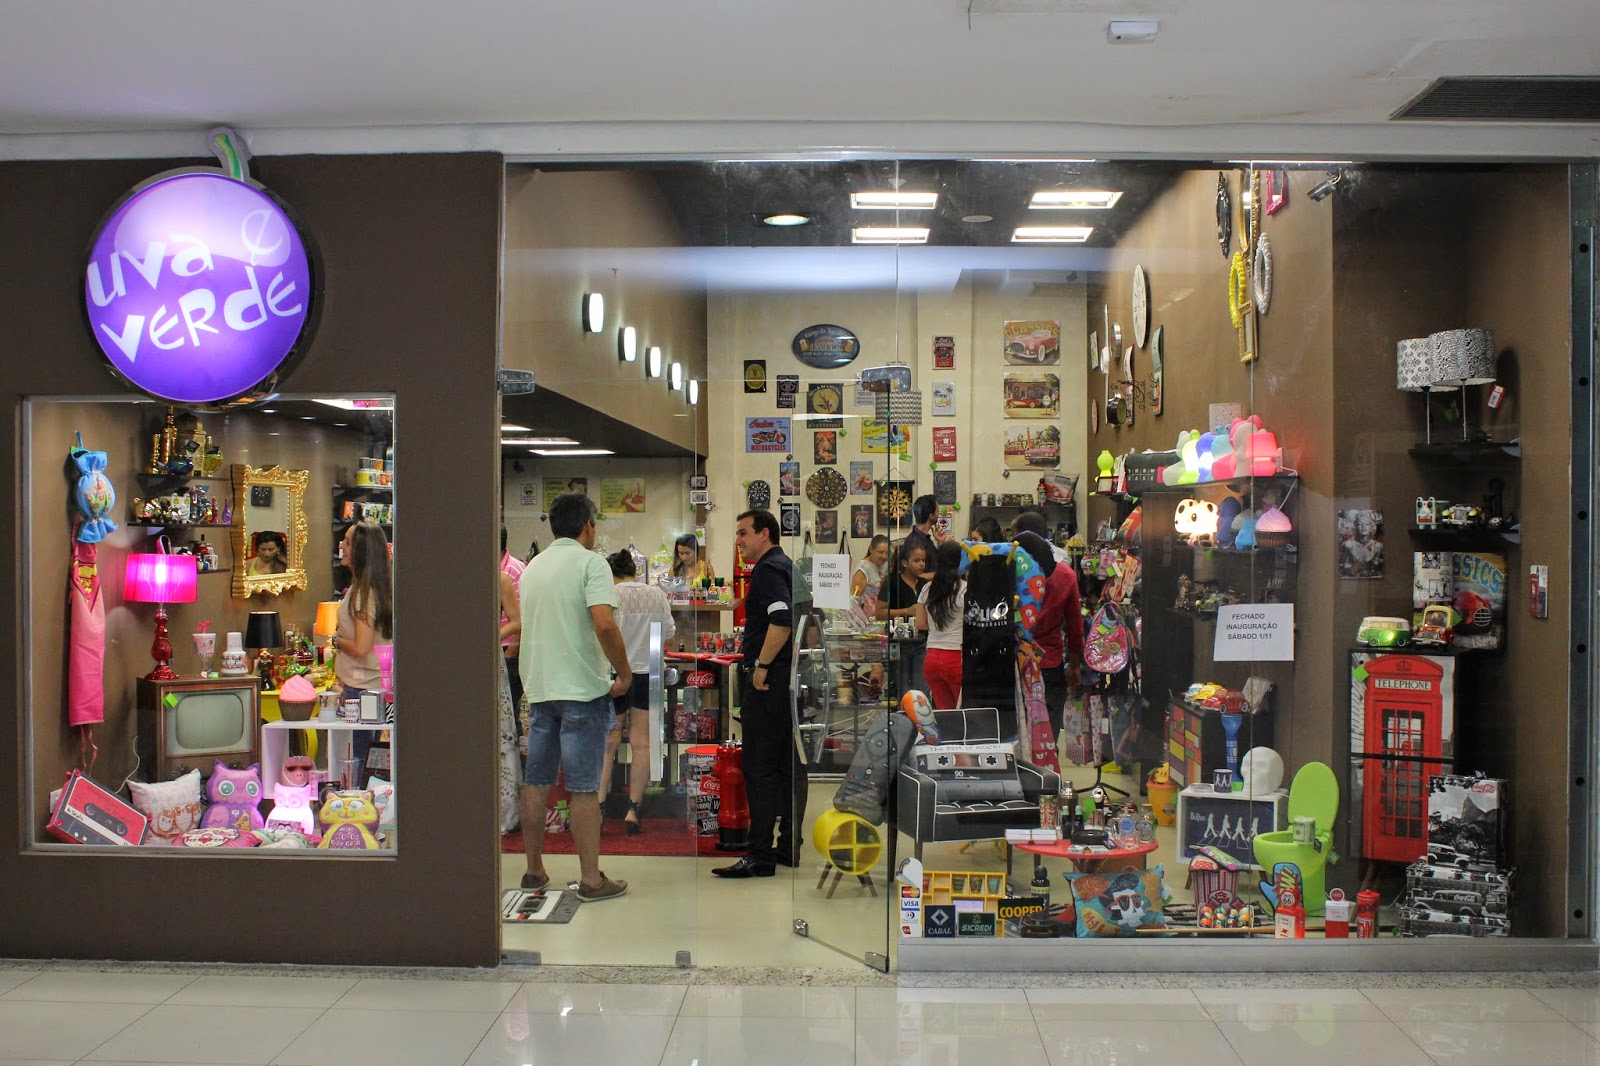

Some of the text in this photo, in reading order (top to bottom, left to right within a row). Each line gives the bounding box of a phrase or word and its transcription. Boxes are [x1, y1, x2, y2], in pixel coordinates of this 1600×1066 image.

[1226, 622, 1278, 630] INAUGURAÇÃO
[1378, 680, 1430, 690] TELEPHONE
[961, 924, 993, 932] SICREDI
